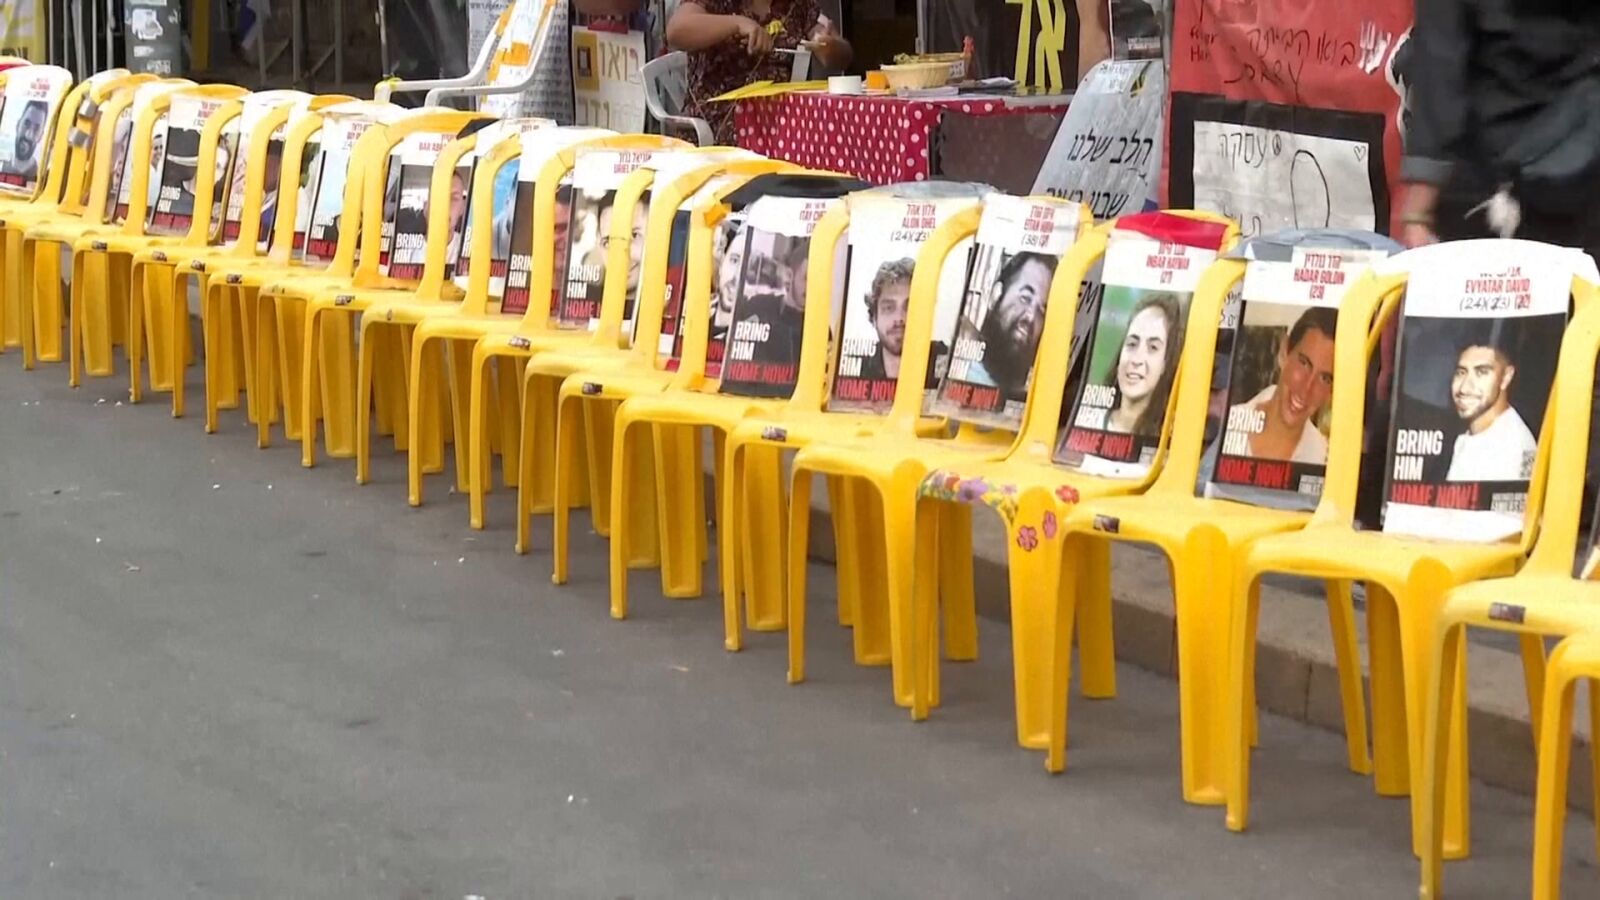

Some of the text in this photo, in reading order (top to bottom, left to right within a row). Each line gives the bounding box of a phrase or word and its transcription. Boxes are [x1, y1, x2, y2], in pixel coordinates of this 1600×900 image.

[1067, 127, 1153, 166] הלב שלנו
[1219, 133, 1267, 172] עסקה
[397, 233, 424, 251] BRING
[510, 254, 533, 271] BRIN
[568, 262, 600, 282] BRING
[507, 271, 528, 288] HIM
[1293, 269, 1345, 285] HADAR GOLDIN
[1465, 278, 1530, 294] EVYATAR DAVID
[566, 281, 588, 299] HIM
[1309, 285, 1325, 300] (23)
[564, 300, 595, 319] HOME
[734, 321, 770, 343] BRING
[730, 340, 755, 361] HIM
[842, 337, 877, 357] BRING
[951, 338, 986, 362] BRING
[728, 361, 797, 386] HOME NOW!
[838, 356, 863, 377] HIM
[947, 356, 971, 381] HIM
[836, 379, 870, 401] HOME
[943, 381, 972, 405] HOME
[1081, 384, 1117, 409] BRING
[1226, 406, 1266, 434] BRING
[1067, 428, 1102, 454] HOME
[1101, 433, 1135, 460] NOW!
[1221, 431, 1249, 456] HIM
[1396, 429, 1444, 455] BRING
[1217, 457, 1254, 484] HOME
[1254, 461, 1293, 490] NOW!
[1392, 456, 1425, 481] HIM
[1391, 482, 1434, 507] HOME
[1434, 482, 1481, 510] NOW!
